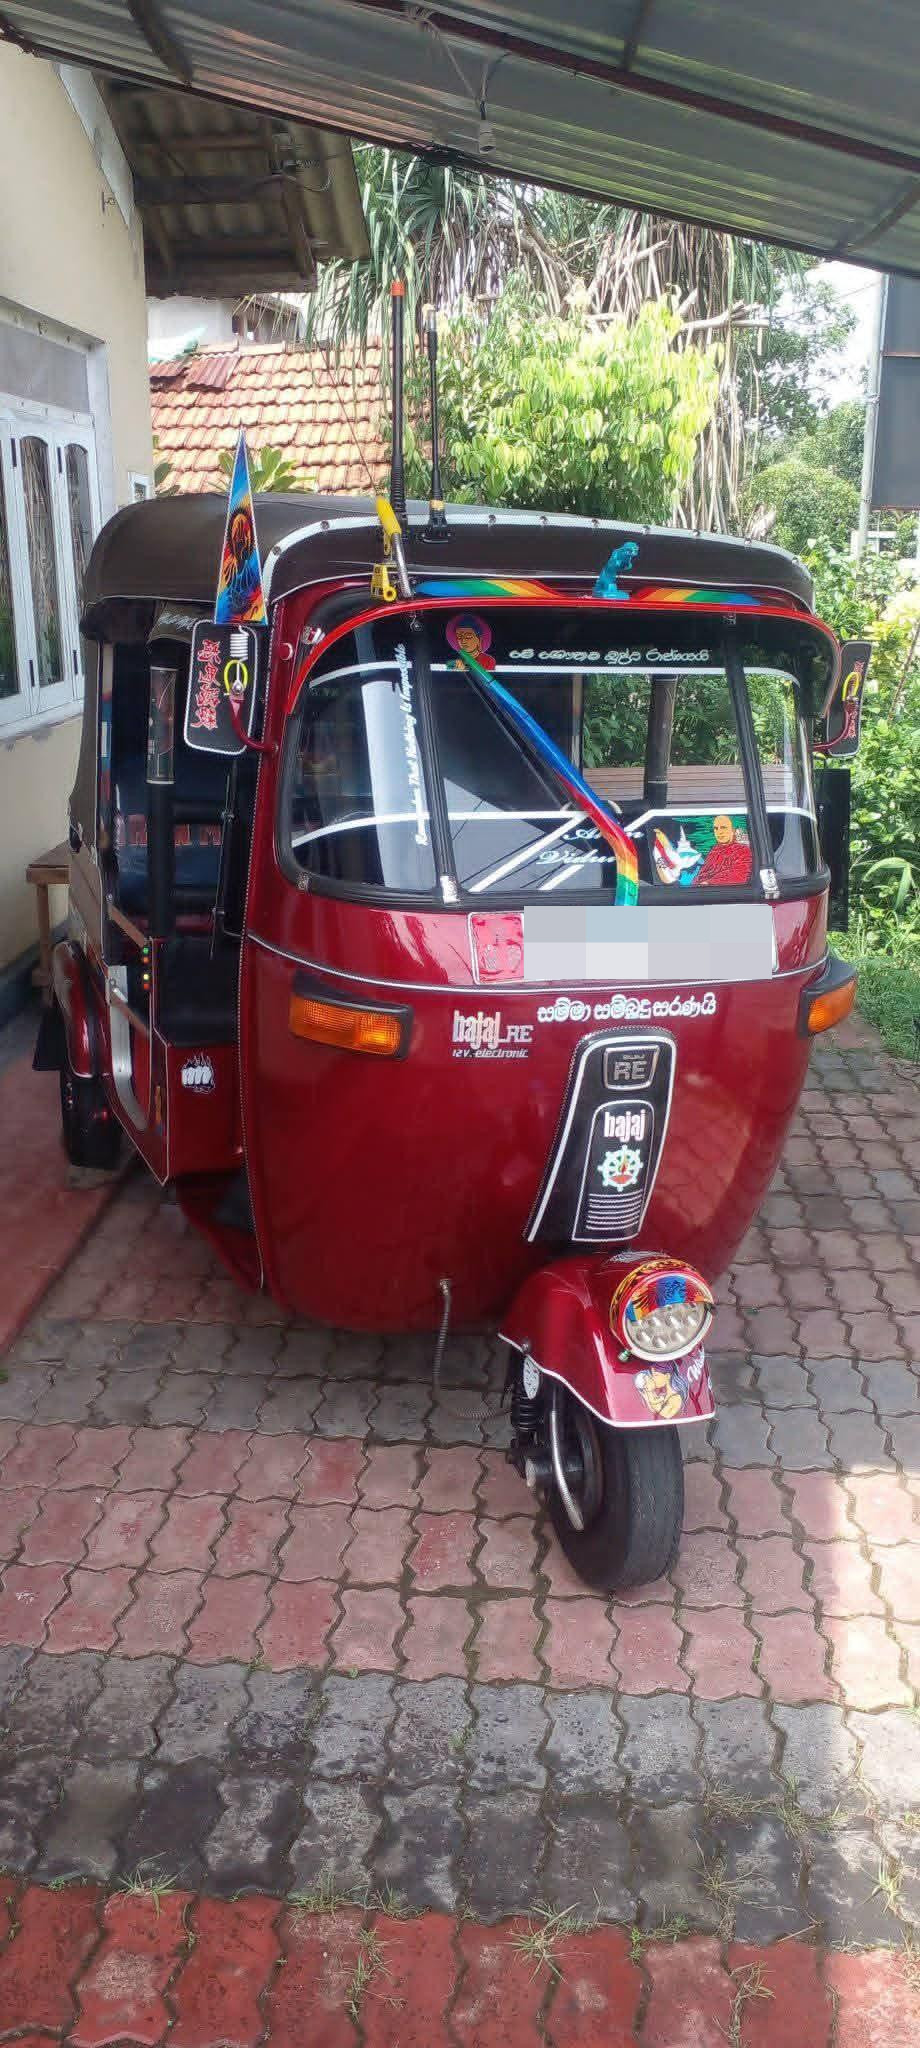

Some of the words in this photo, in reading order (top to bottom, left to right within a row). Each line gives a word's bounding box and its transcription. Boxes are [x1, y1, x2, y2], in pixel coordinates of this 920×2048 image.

[537, 997, 591, 1022] සම්මා
[614, 1061, 647, 1080] RE
[604, 1110, 646, 1142] bajaj
